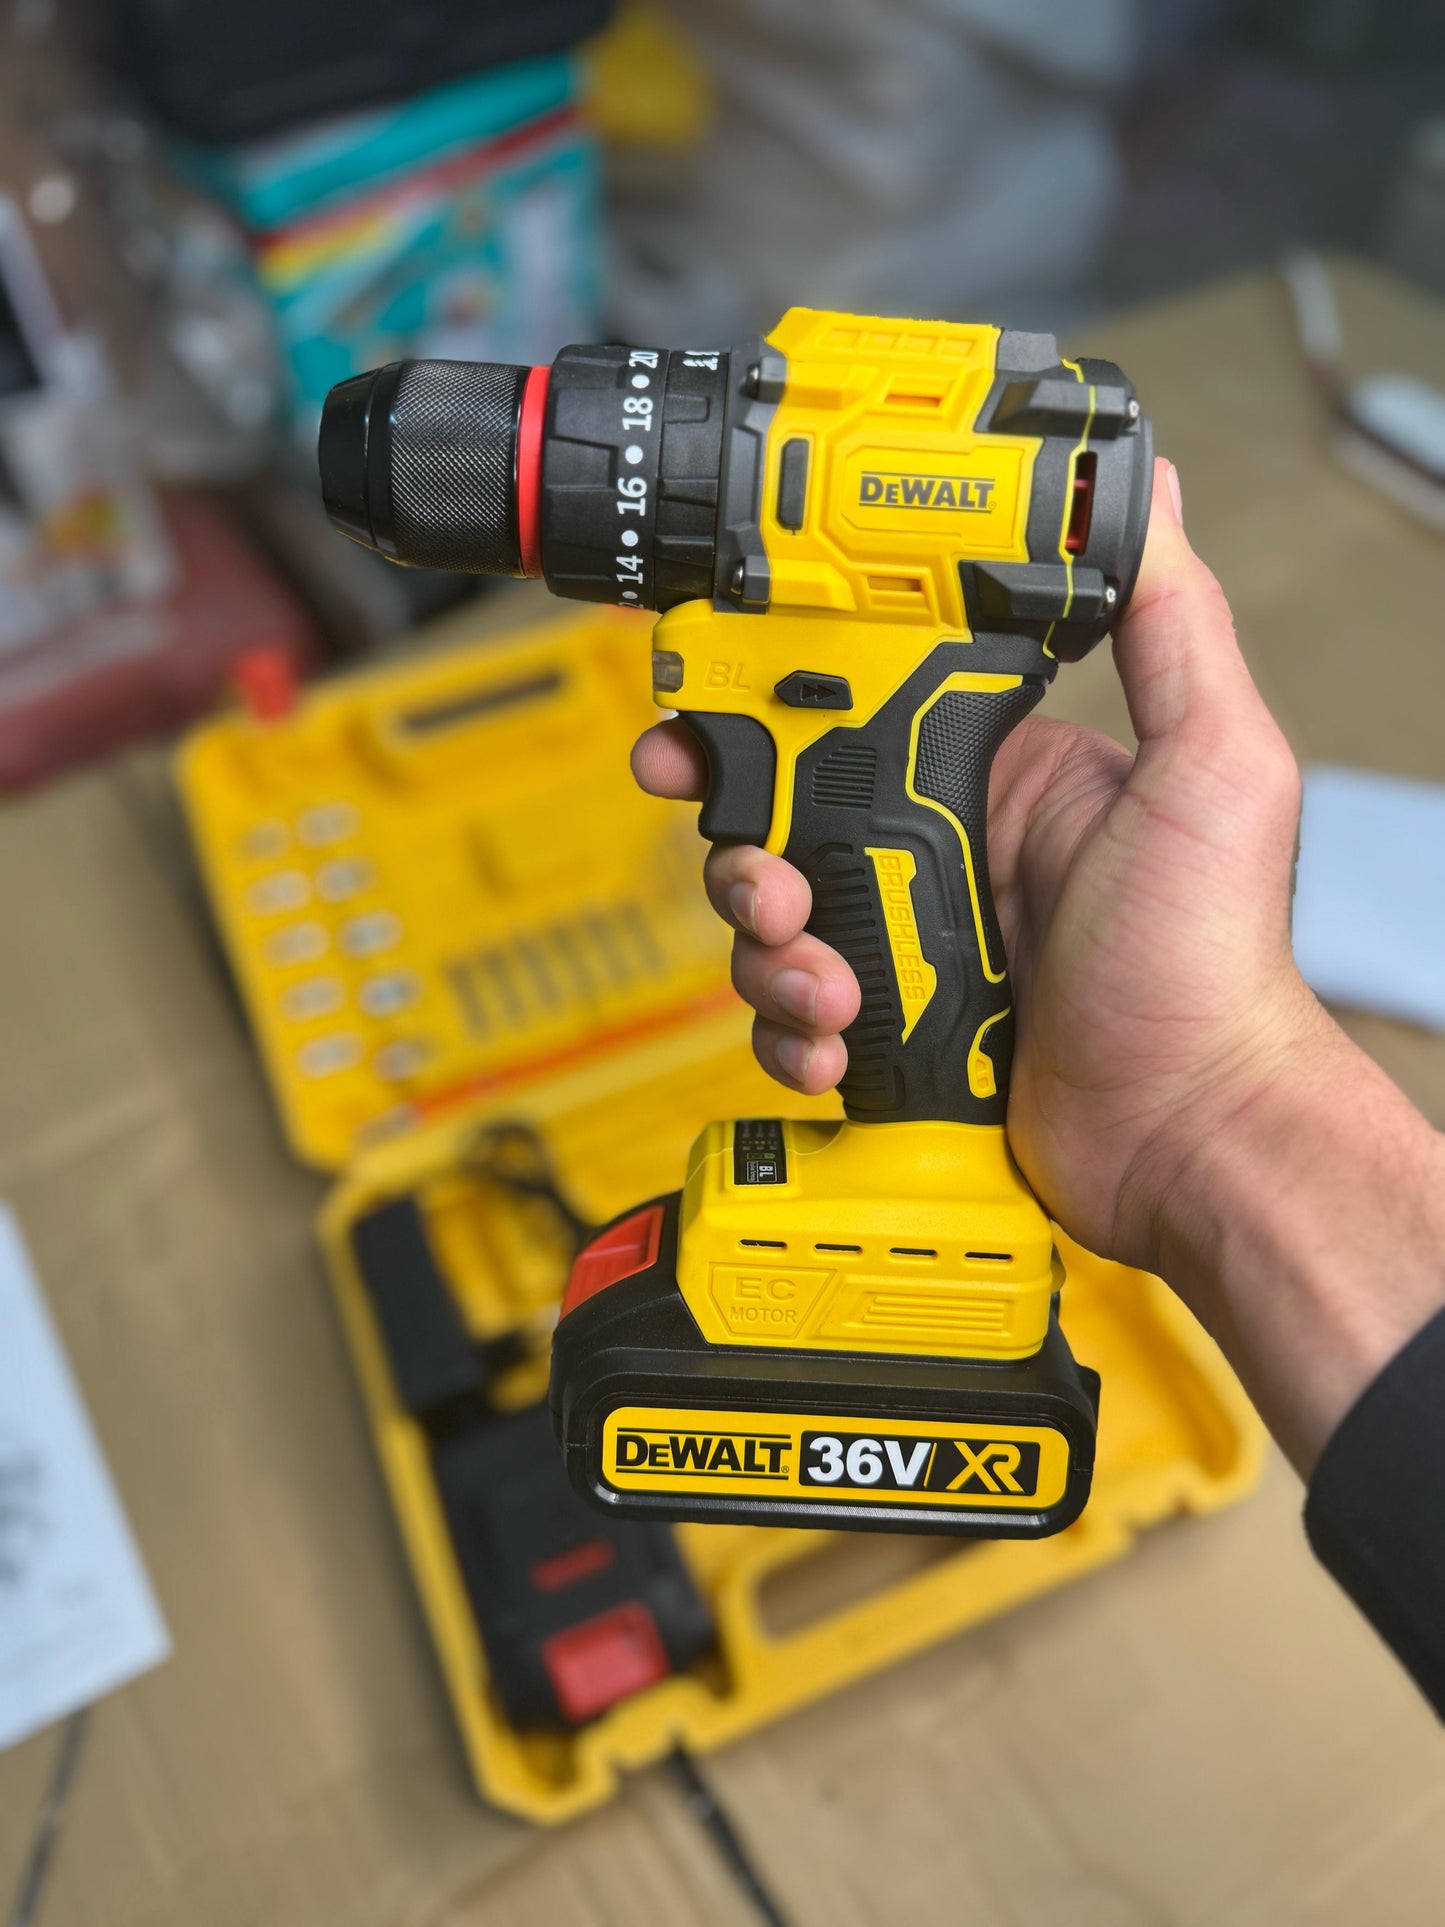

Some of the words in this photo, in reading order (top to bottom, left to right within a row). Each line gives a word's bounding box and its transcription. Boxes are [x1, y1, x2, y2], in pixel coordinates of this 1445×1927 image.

[629, 351, 659, 368] 20
[622, 397, 654, 431] 18
[616, 477, 647, 516] 16
[616, 555, 643, 584] 14
[704, 661, 750, 692] BL
[877, 855, 926, 1001] BRUSHLESS
[735, 1276, 796, 1302] EC
[729, 1306, 797, 1324] MOTOR
[945, 1441, 1025, 1493] XR
